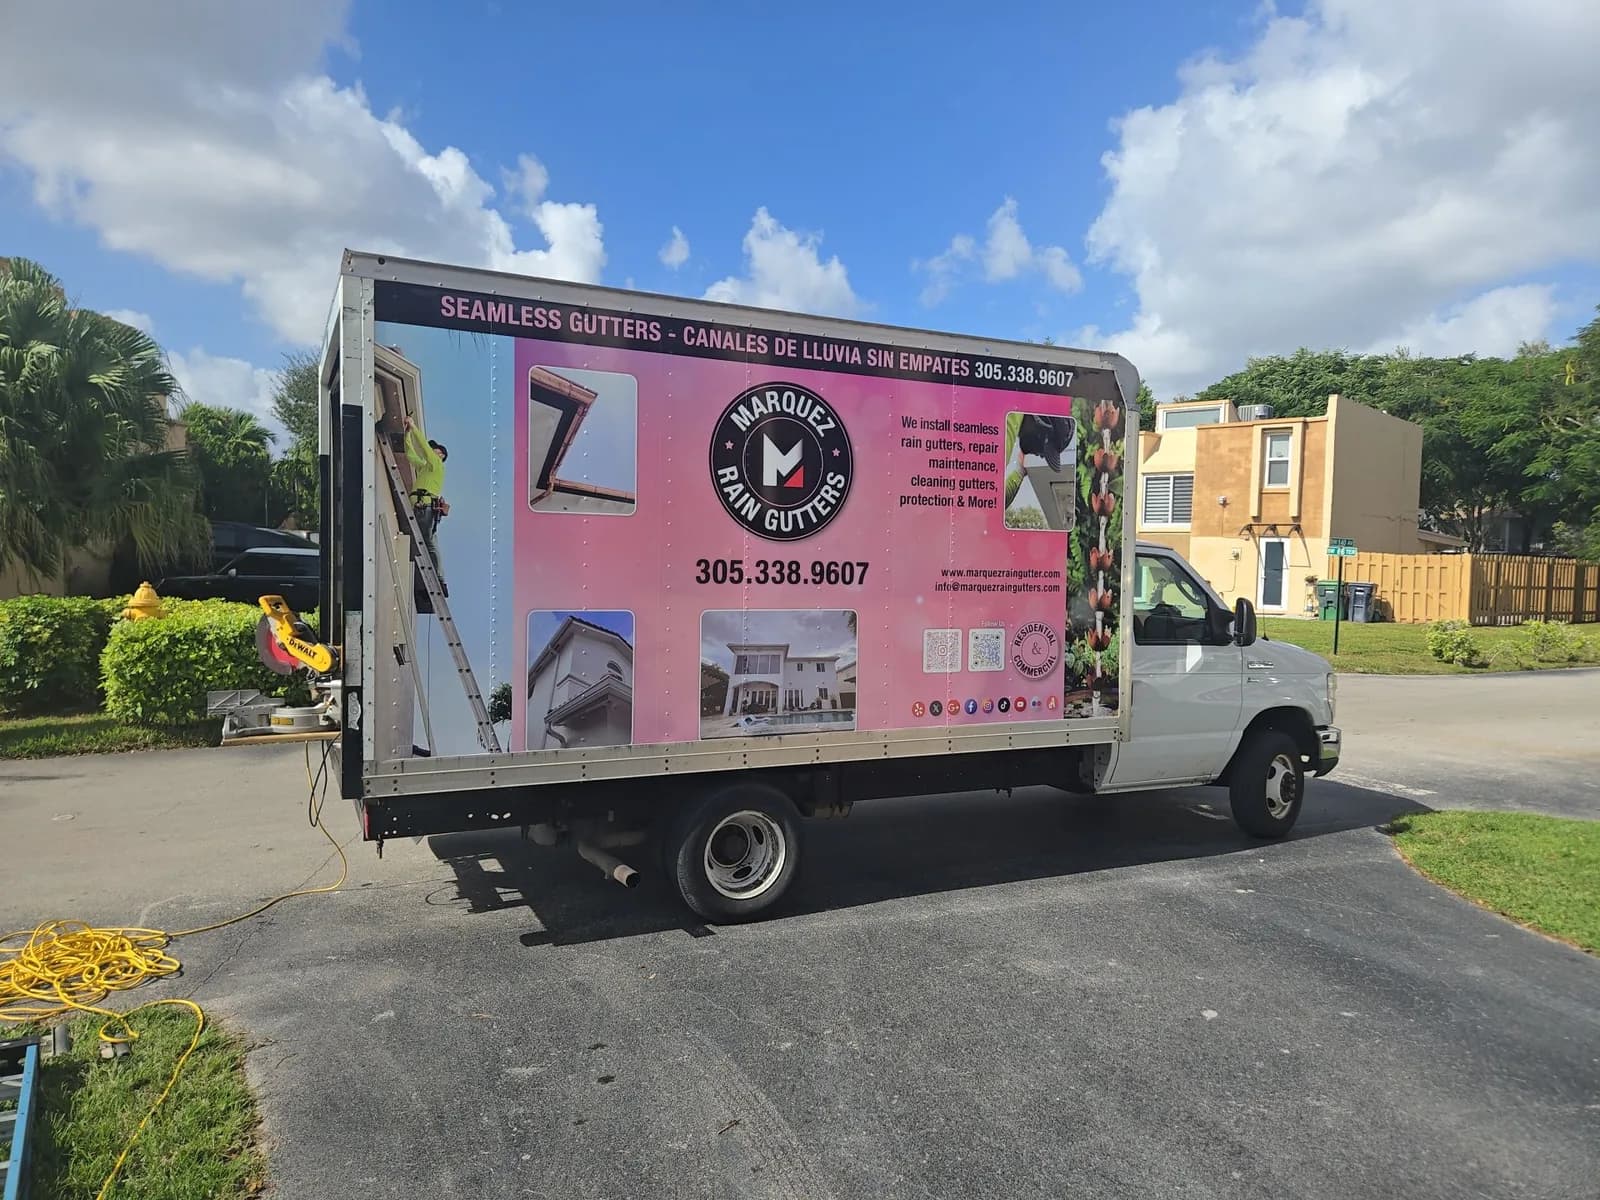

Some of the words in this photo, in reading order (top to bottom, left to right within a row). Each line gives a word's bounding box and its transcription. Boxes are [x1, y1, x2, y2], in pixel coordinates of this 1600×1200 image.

[441, 295, 561, 330] SEAMLESS
[570, 312, 661, 342] GUTTERS
[683, 325, 769, 355] CANALES
[774, 338, 797, 359] DE
[803, 341, 862, 365] LLUVIA
[867, 348, 893, 369] SIN
[900, 351, 970, 377] EMPATES
[975, 361, 1074, 388] 305.338.9607
[730, 390, 835, 437] MARQUEZ
[901, 415, 917, 428] We
[920, 417, 950, 431] install
[953, 422, 999, 435] seamless
[901, 436, 921, 448] rain
[925, 439, 966, 454] gutters,
[968, 442, 999, 455] repair
[929, 457, 998, 473] maintenance,
[911, 475, 955, 490] cleaning
[959, 479, 998, 492] gutters,
[717, 465, 762, 521] RAIN
[764, 472, 845, 532] GUTTERS
[900, 494, 953, 507] protection
[957, 496, 965, 507] &
[968, 496, 997, 508] More!
[695, 558, 869, 585] 305.338.9607
[941, 568, 1060, 580] www.marquezraingutter.com
[935, 581, 1060, 594] info@marquezraingutters.com
[1014, 623, 1056, 647] RESIDENTIAL
[1031, 641, 1042, 655] &
[1013, 655, 1056, 676] COMMERCIAL
